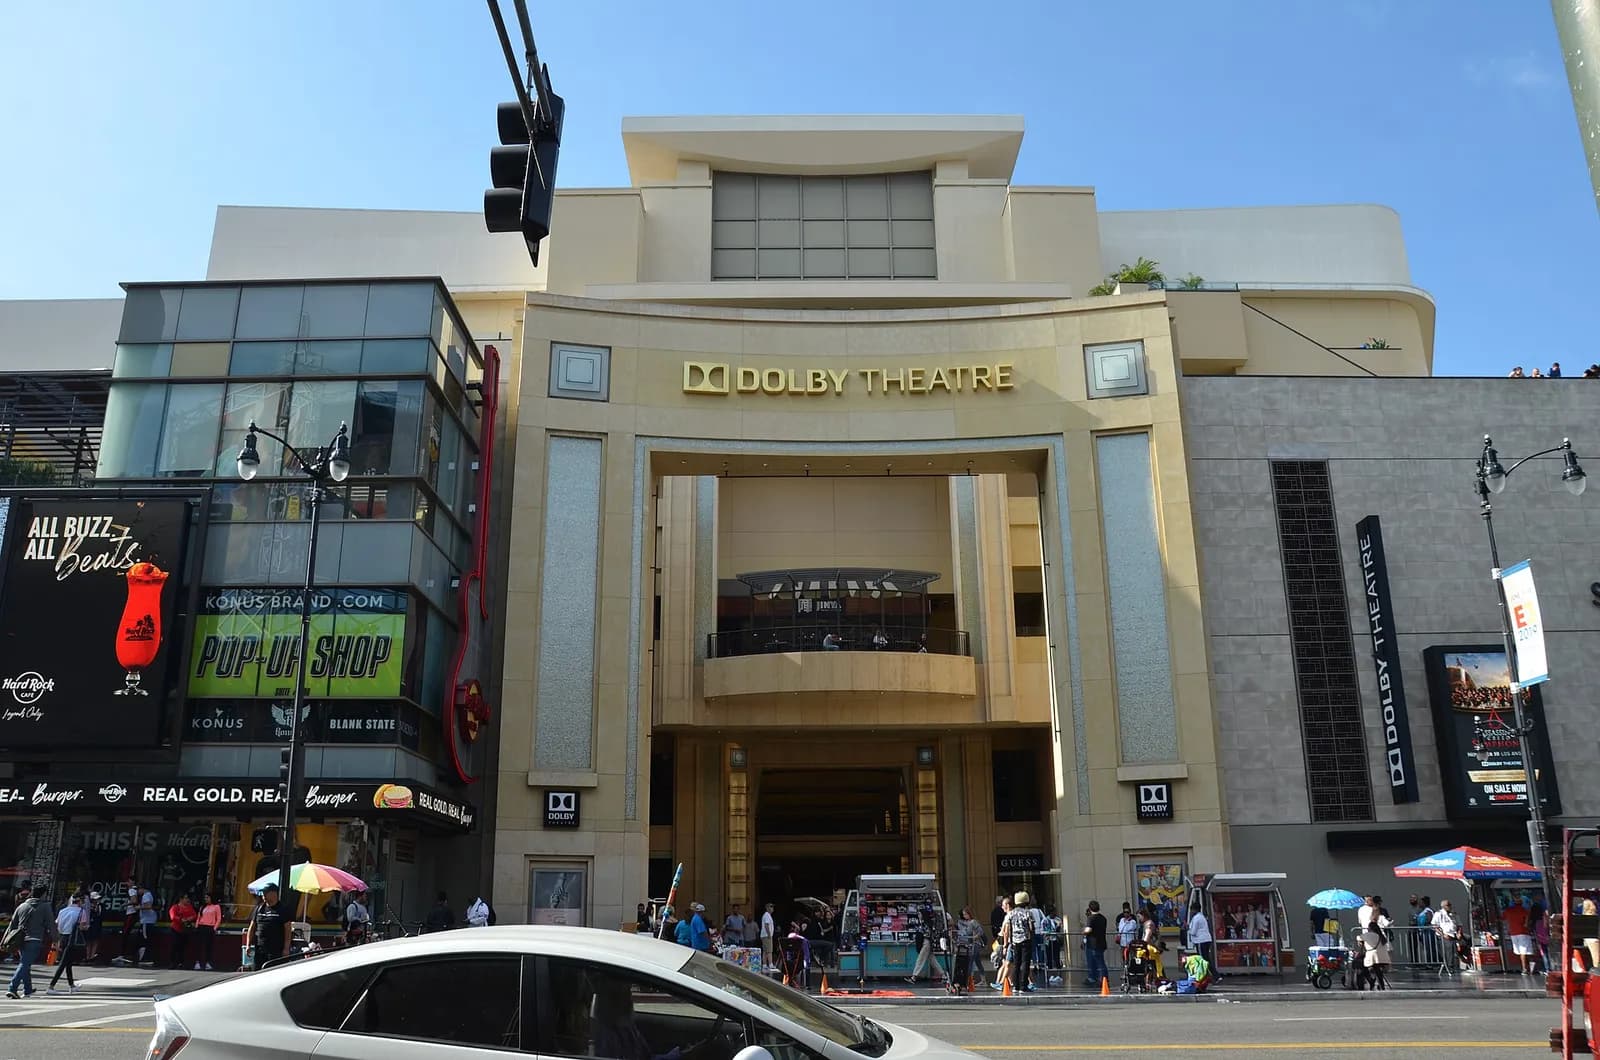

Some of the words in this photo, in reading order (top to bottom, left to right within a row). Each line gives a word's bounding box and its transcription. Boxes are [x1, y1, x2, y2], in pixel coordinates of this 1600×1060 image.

[736, 367, 849, 395] DOLBY
[857, 361, 1016, 394] THEATRE
[27, 516, 59, 538] ALL
[64, 516, 116, 538] BUZZ.
[24, 538, 56, 560] ALL
[55, 527, 142, 581] Beats.
[206, 596, 265, 609] KONUS
[1359, 533, 1386, 652] THEATRE
[310, 635, 393, 678] SHOP
[2, 678, 31, 690] Hard
[29, 678, 54, 692] Rock
[1376, 658, 1399, 745] DOLBY
[191, 718, 244, 729] KONUS
[329, 719, 363, 729] BLANK
[365, 719, 396, 729] STATE
[31, 782, 84, 805] Burger.
[143, 788, 189, 802] REAL
[194, 788, 246, 802] GOLD.
[305, 785, 358, 808] Burger.
[418, 792, 433, 810] REAL
[448, 803, 460, 819] REAL
[1141, 804, 1168, 813] DOLBY
[548, 812, 575, 821] DOLBY
[81, 832, 130, 850] THIS
[167, 833, 198, 847] Hard
[1000, 858, 1039, 868] GUESS
